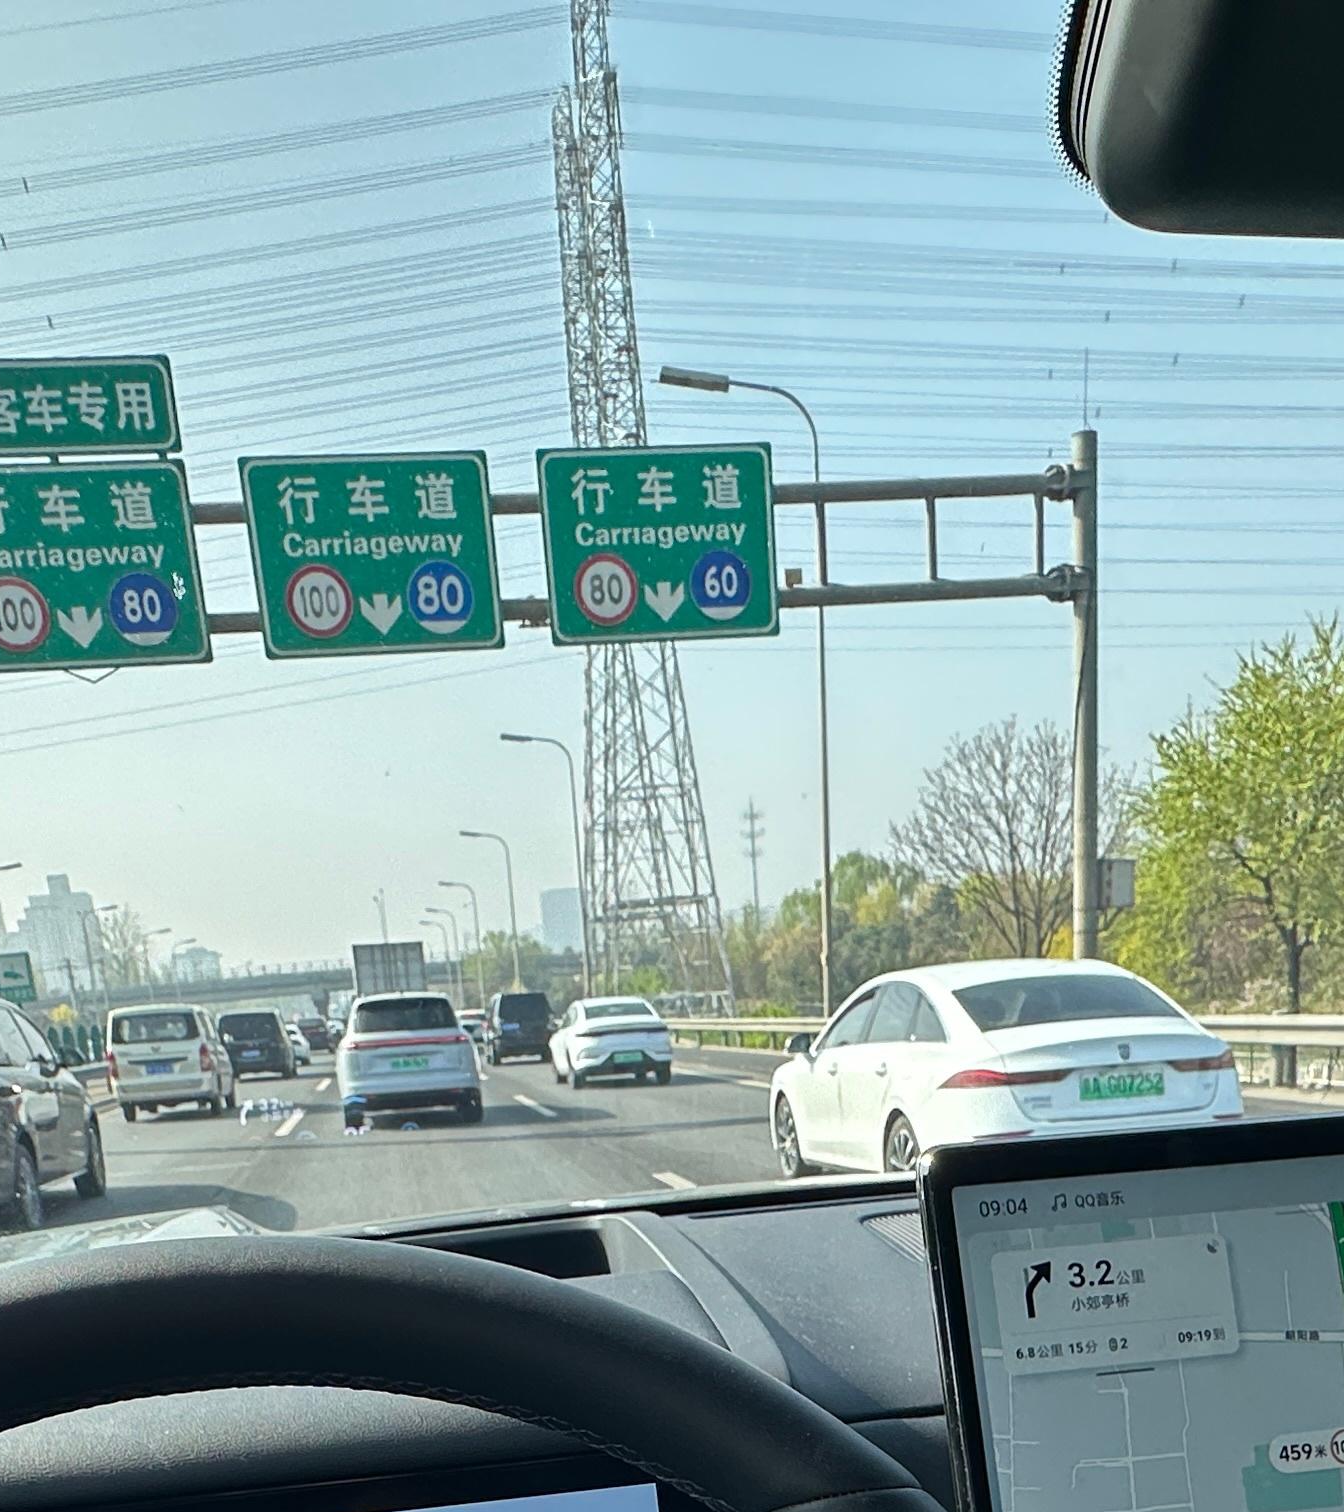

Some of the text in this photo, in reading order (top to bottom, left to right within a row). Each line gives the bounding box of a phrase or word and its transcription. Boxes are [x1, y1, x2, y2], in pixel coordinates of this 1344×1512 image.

[277, 472, 458, 525] 行车道
[570, 463, 742, 516] 行车道
[282, 530, 464, 560] Carriageway
[574, 521, 747, 549] Carriageway
[416, 574, 464, 615] 80
[589, 574, 623, 606] 80
[704, 565, 738, 598] 60
[123, 588, 161, 622] 80
[299, 584, 341, 619] 100
[978, 1197, 1029, 1218] 09:04
[1074, 1190, 1126, 1210] QQ音乐
[1071, 1292, 1131, 1313] 小郊亭桥
